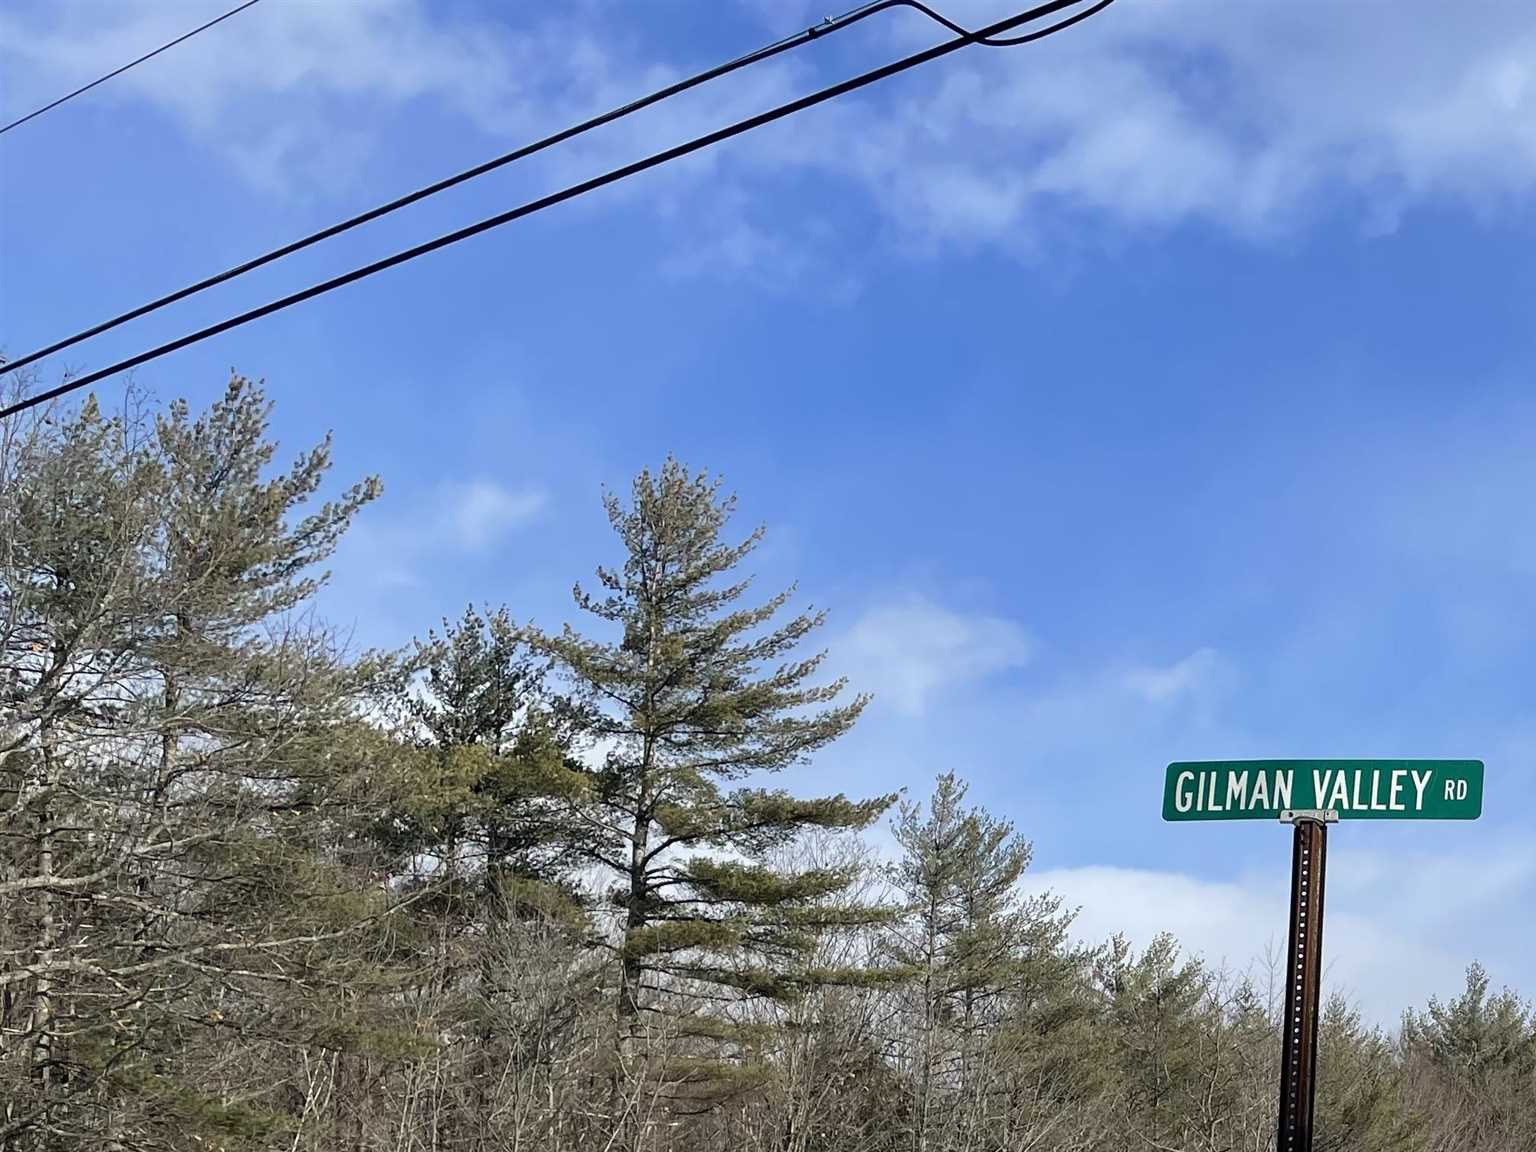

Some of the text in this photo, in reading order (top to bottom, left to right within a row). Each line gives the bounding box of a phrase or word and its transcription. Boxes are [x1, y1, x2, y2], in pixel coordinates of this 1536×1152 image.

[1174, 769, 1468, 812] GILMAN VALLEY RD
